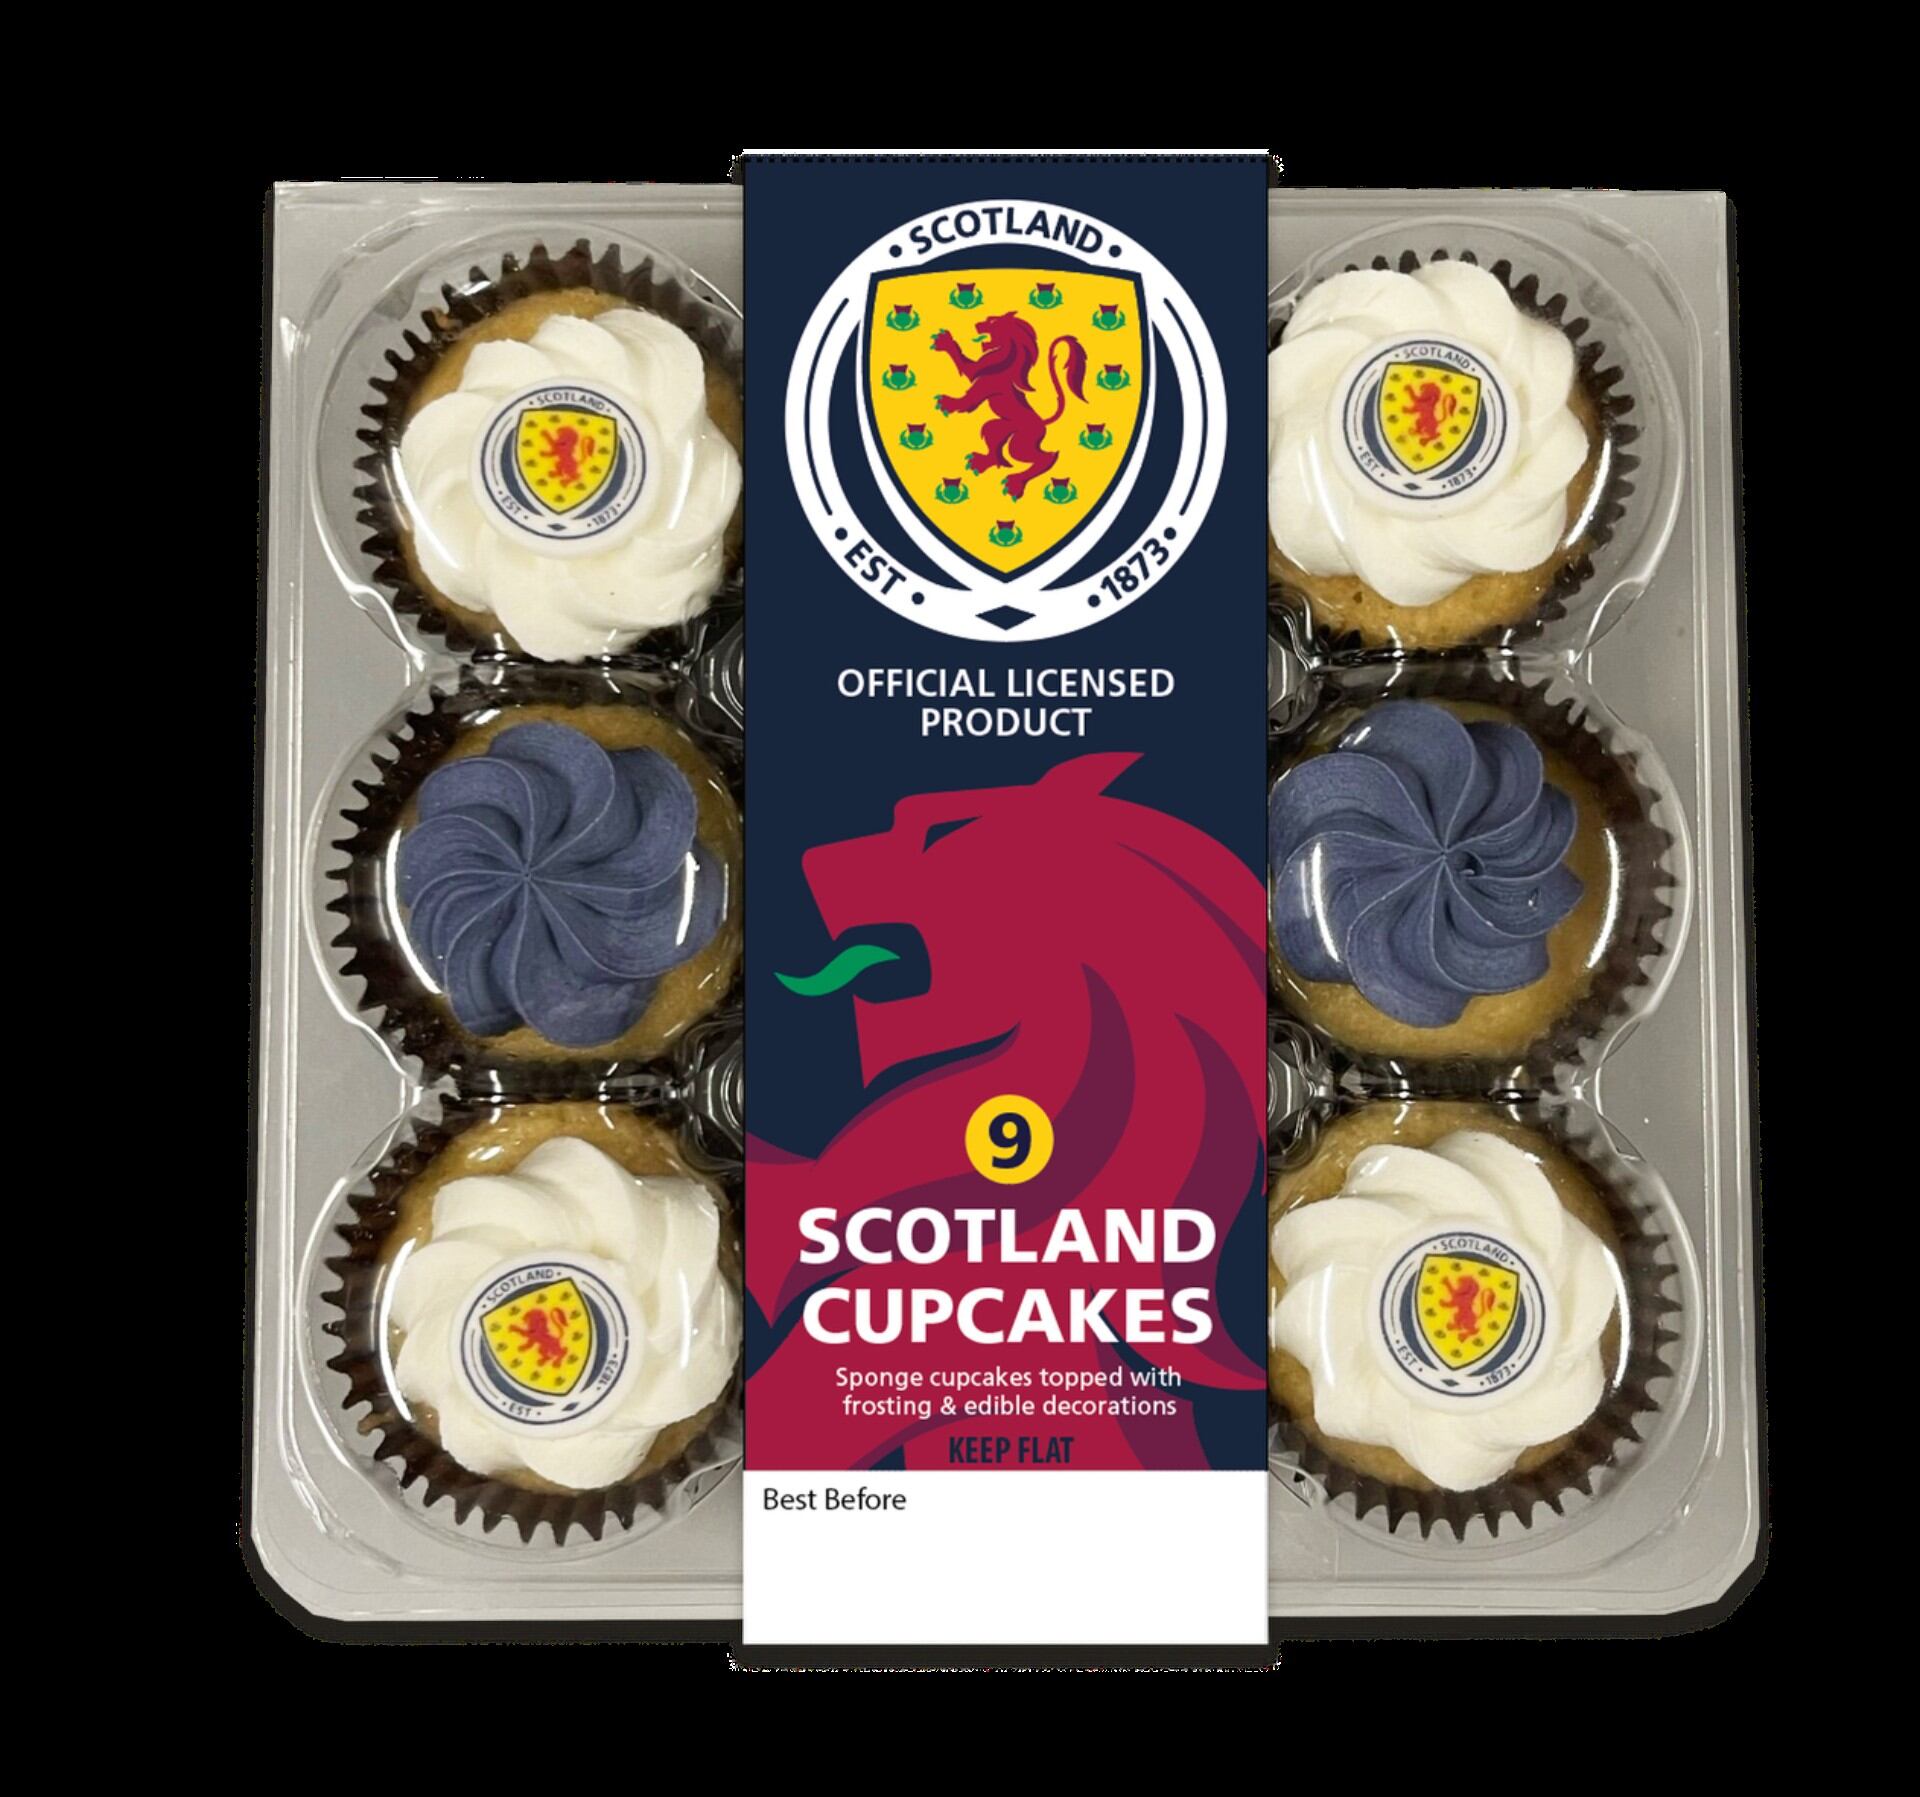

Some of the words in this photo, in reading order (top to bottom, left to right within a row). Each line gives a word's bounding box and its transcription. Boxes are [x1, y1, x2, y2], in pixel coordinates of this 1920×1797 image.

[909, 206, 1103, 256] SCOTLAND
[1403, 346, 1471, 370] SCOTLAND
[536, 392, 605, 411] SCOTLAND
[1359, 452, 1379, 472] EST
[1448, 468, 1474, 488] 1873
[500, 495, 521, 515] EST
[592, 507, 619, 526] 1873
[844, 542, 906, 595] EST
[1099, 537, 1170, 600] 1873
[838, 668, 995, 697] OFFICIAL
[1007, 668, 1175, 697] LICENSED
[921, 707, 1092, 736] PRODUCT
[988, 1112, 1032, 1169] 9
[799, 1207, 1216, 1264] SCOTLAND
[1440, 1238, 1508, 1263] SCOTLAND
[487, 1269, 554, 1302] SCOTLAND
[802, 1287, 1214, 1344] CUPCAKES
[1397, 1346, 1418, 1367] EST
[598, 1359, 619, 1385] 1873
[835, 1367, 923, 1391] Sponge
[929, 1367, 1032, 1391] cupcakes
[1039, 1367, 1123, 1391] topped
[1130, 1367, 1182, 1387] with
[1486, 1366, 1512, 1386] 1873
[509, 1402, 532, 1417] EST
[842, 1395, 932, 1419] frosting
[939, 1397, 957, 1416] &
[964, 1395, 1035, 1416] edible
[1042, 1395, 1177, 1416] decorations
[949, 1437, 1011, 1464] KEEP
[1018, 1437, 1074, 1464] FLAT
[763, 1488, 817, 1511] Best
[824, 1487, 907, 1511] Before
